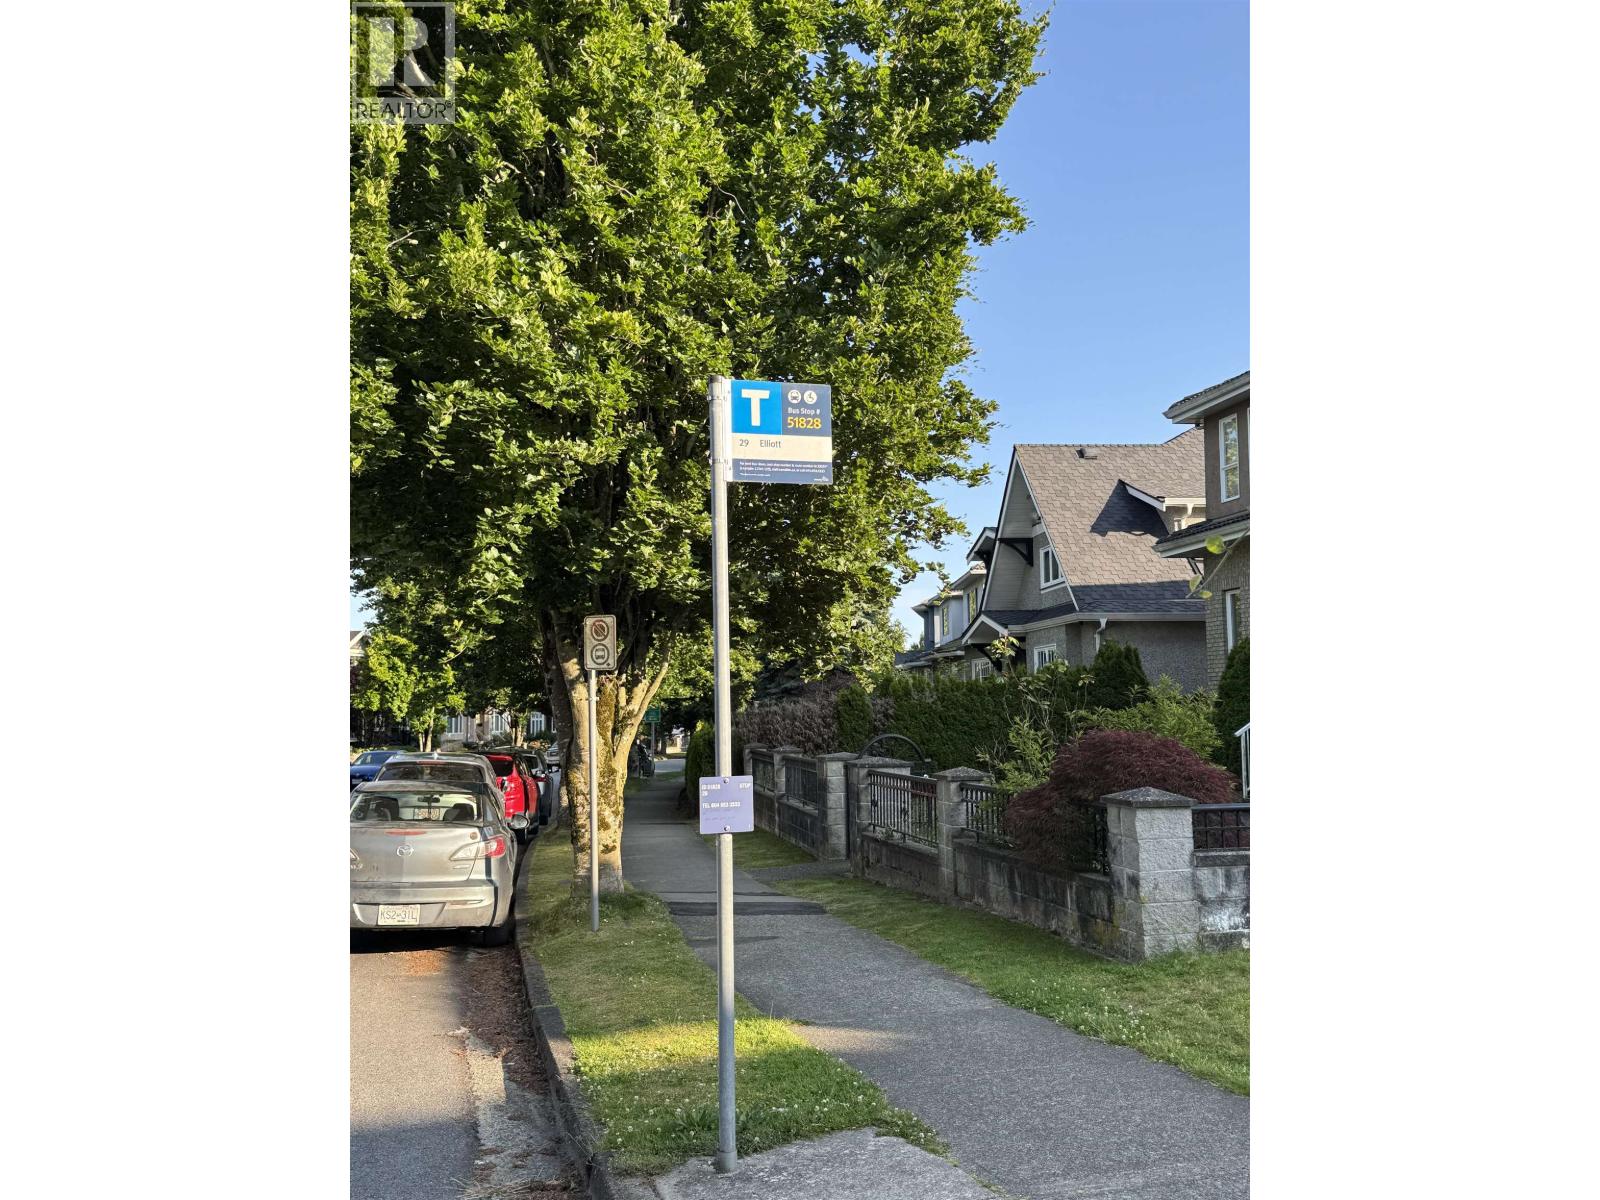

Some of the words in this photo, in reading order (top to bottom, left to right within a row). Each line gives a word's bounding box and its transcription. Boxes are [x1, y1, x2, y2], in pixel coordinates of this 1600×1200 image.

[741, 388, 771, 427] T
[787, 406, 800, 414] Bus
[800, 407, 815, 416] Stop
[787, 416, 822, 429] 51828
[739, 438, 750, 447] 29
[759, 439, 782, 448] Elliott
